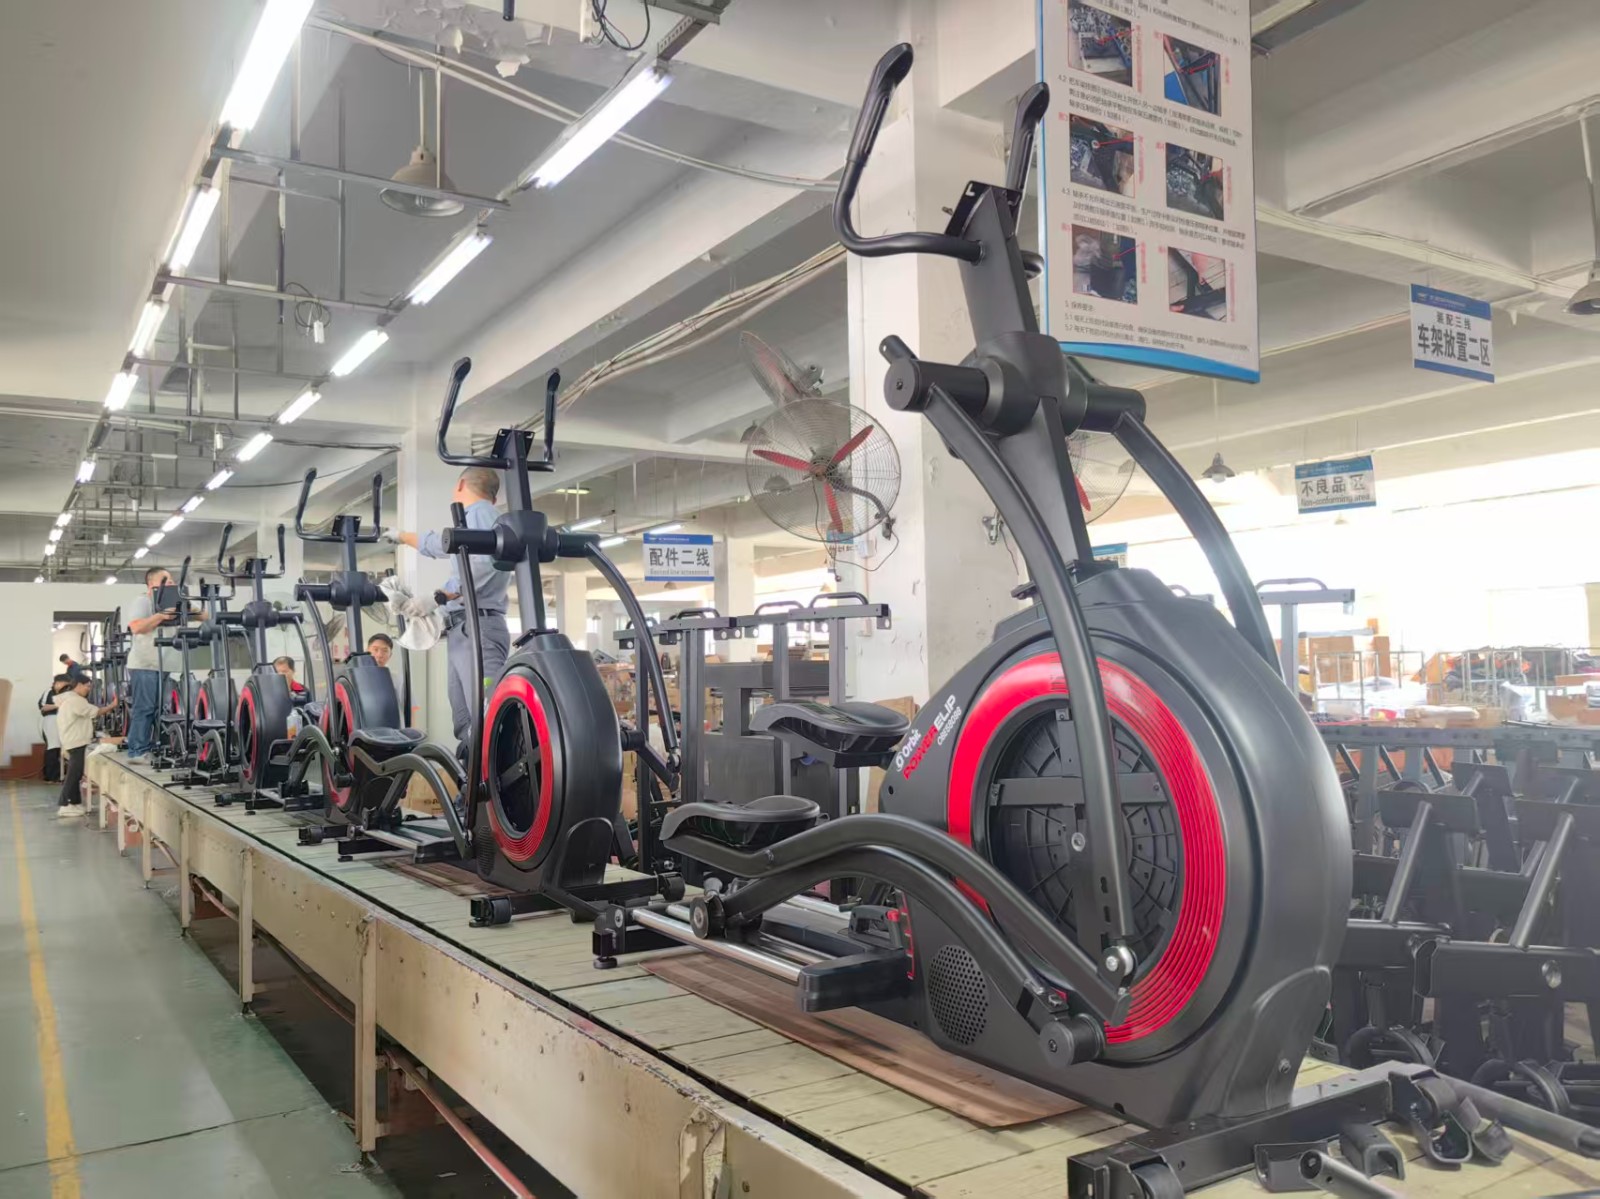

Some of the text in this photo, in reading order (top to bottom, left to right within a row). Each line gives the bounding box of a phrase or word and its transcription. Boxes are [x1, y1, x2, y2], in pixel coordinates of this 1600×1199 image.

[1418, 323, 1490, 366] 车架放置二区
[1301, 474, 1366, 497] 不良品区
[648, 547, 710, 567] 配件二线
